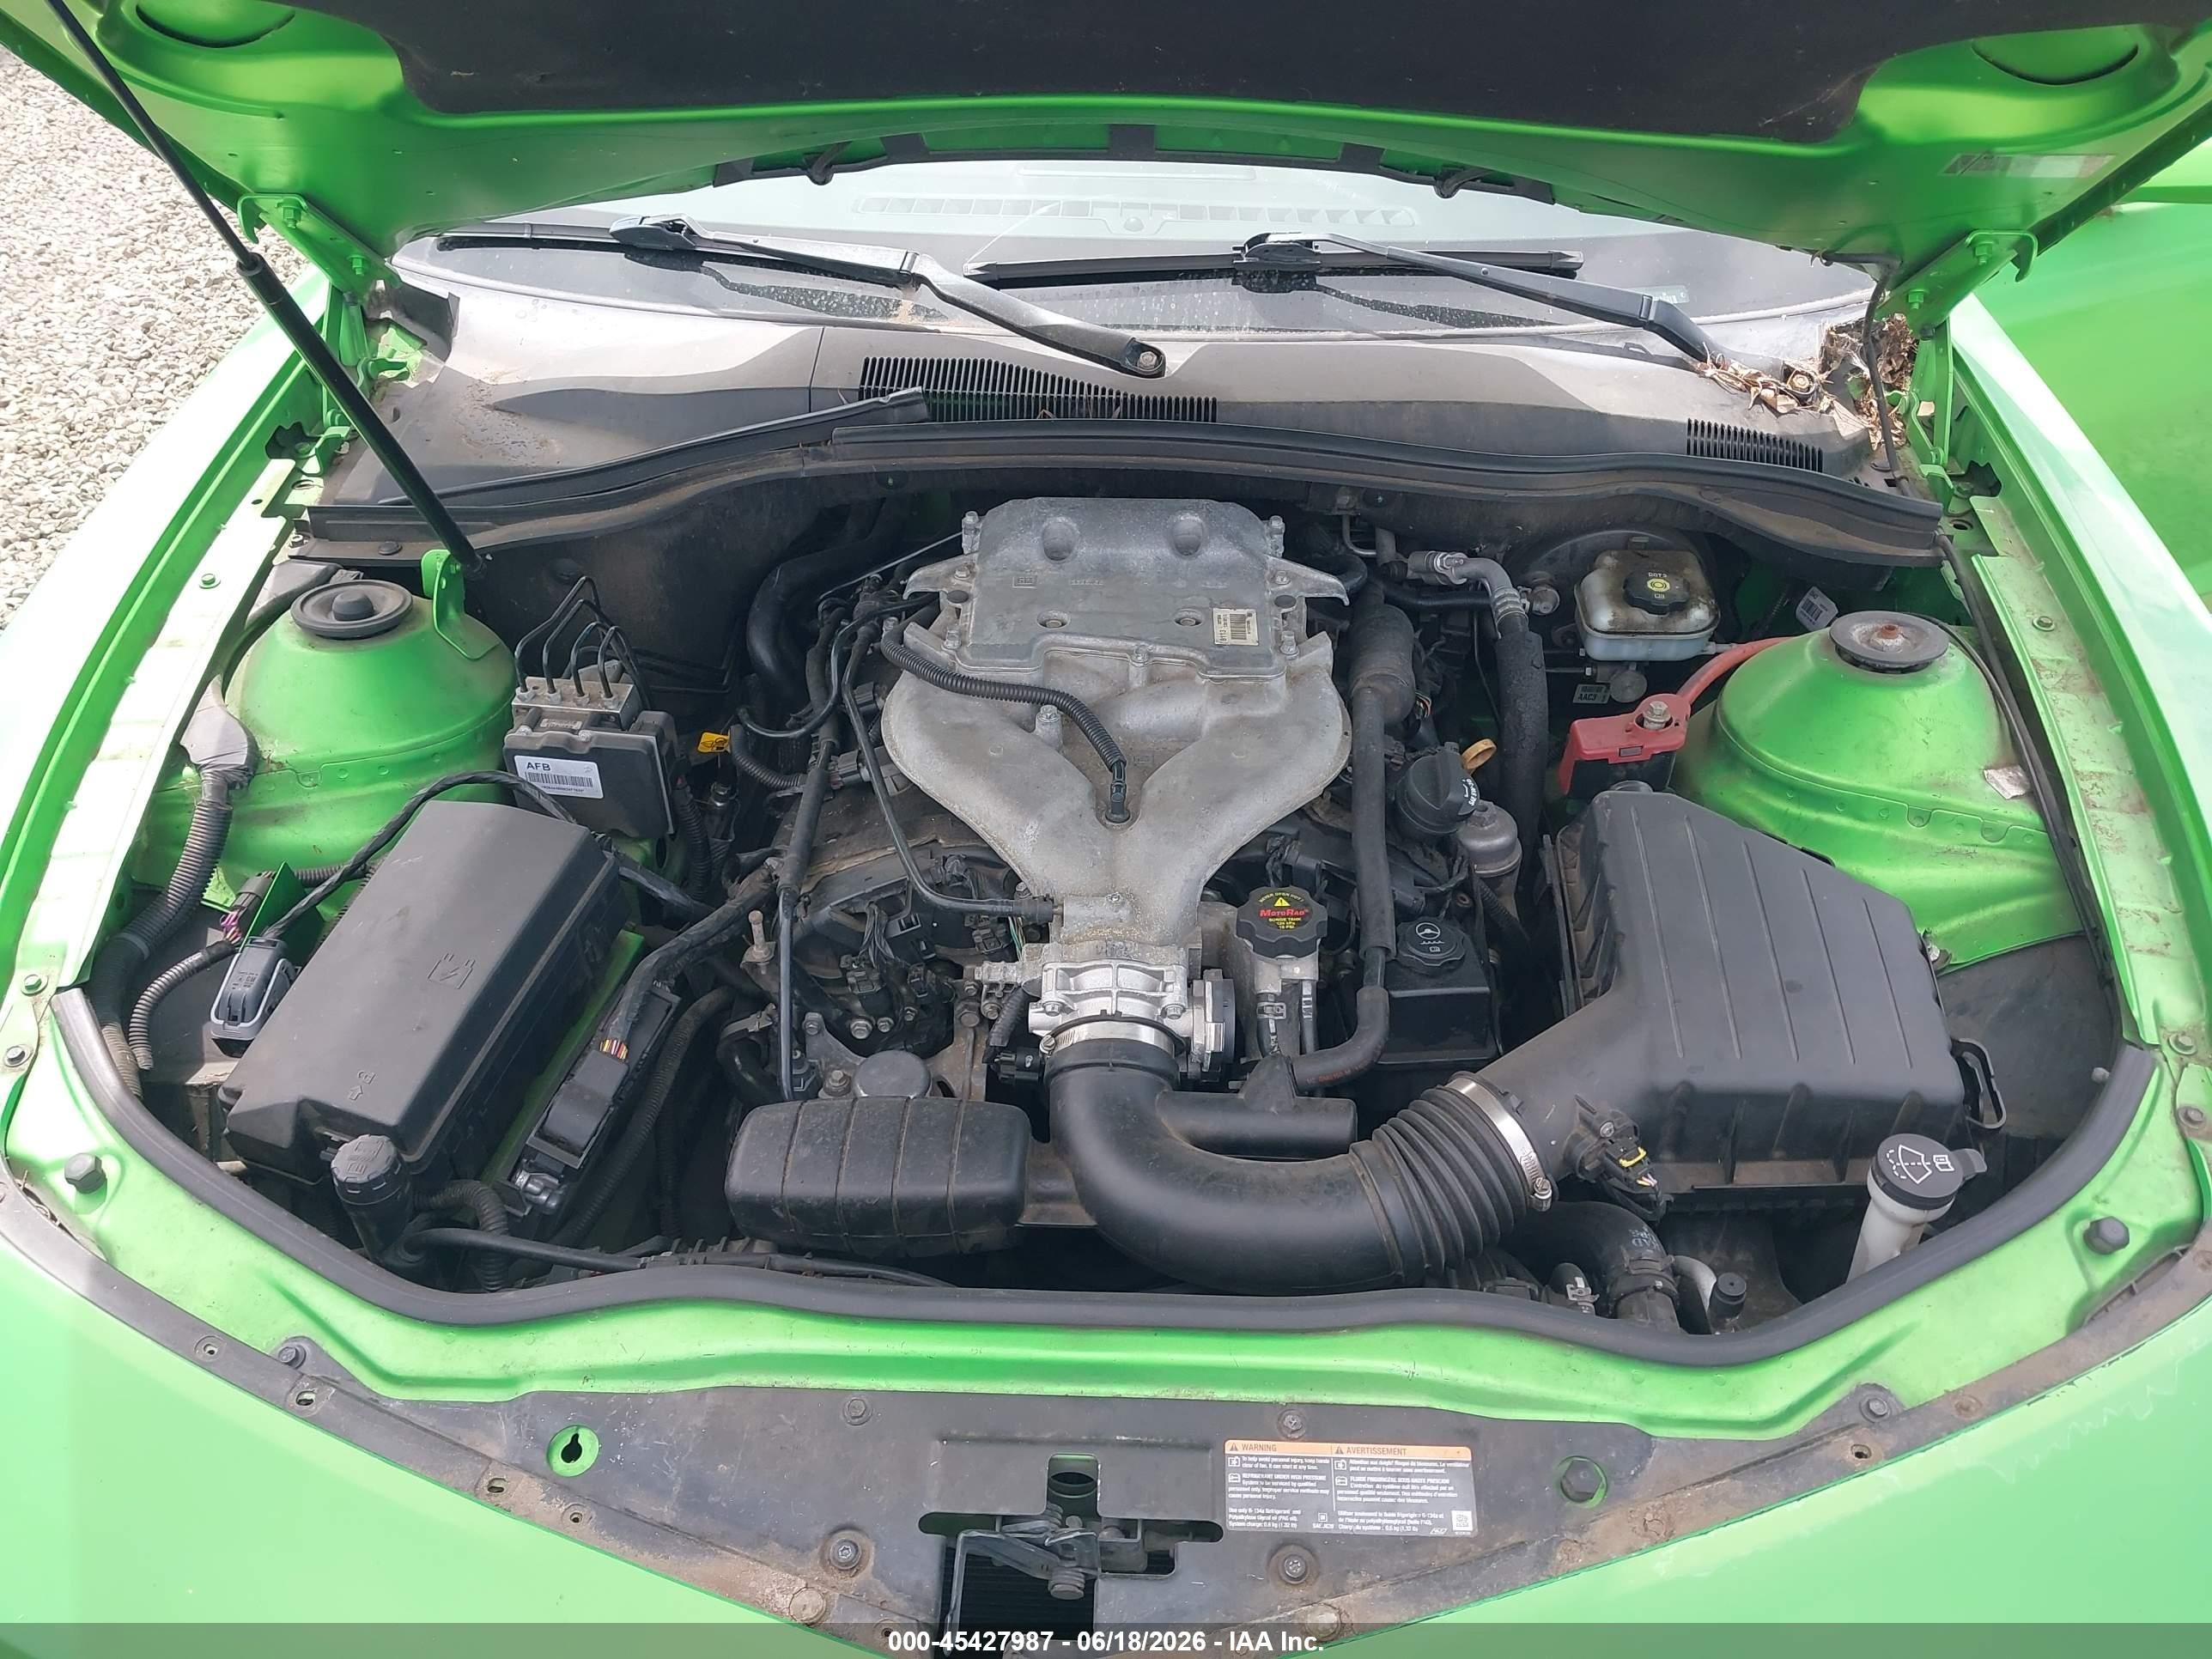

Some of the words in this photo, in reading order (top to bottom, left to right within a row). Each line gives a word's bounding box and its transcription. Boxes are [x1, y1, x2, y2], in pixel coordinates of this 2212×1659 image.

[526, 762, 550, 771] AFB
[1242, 1443, 1276, 1451] WARNING
[1346, 1446, 1407, 1455] AVERTISSEMENT
